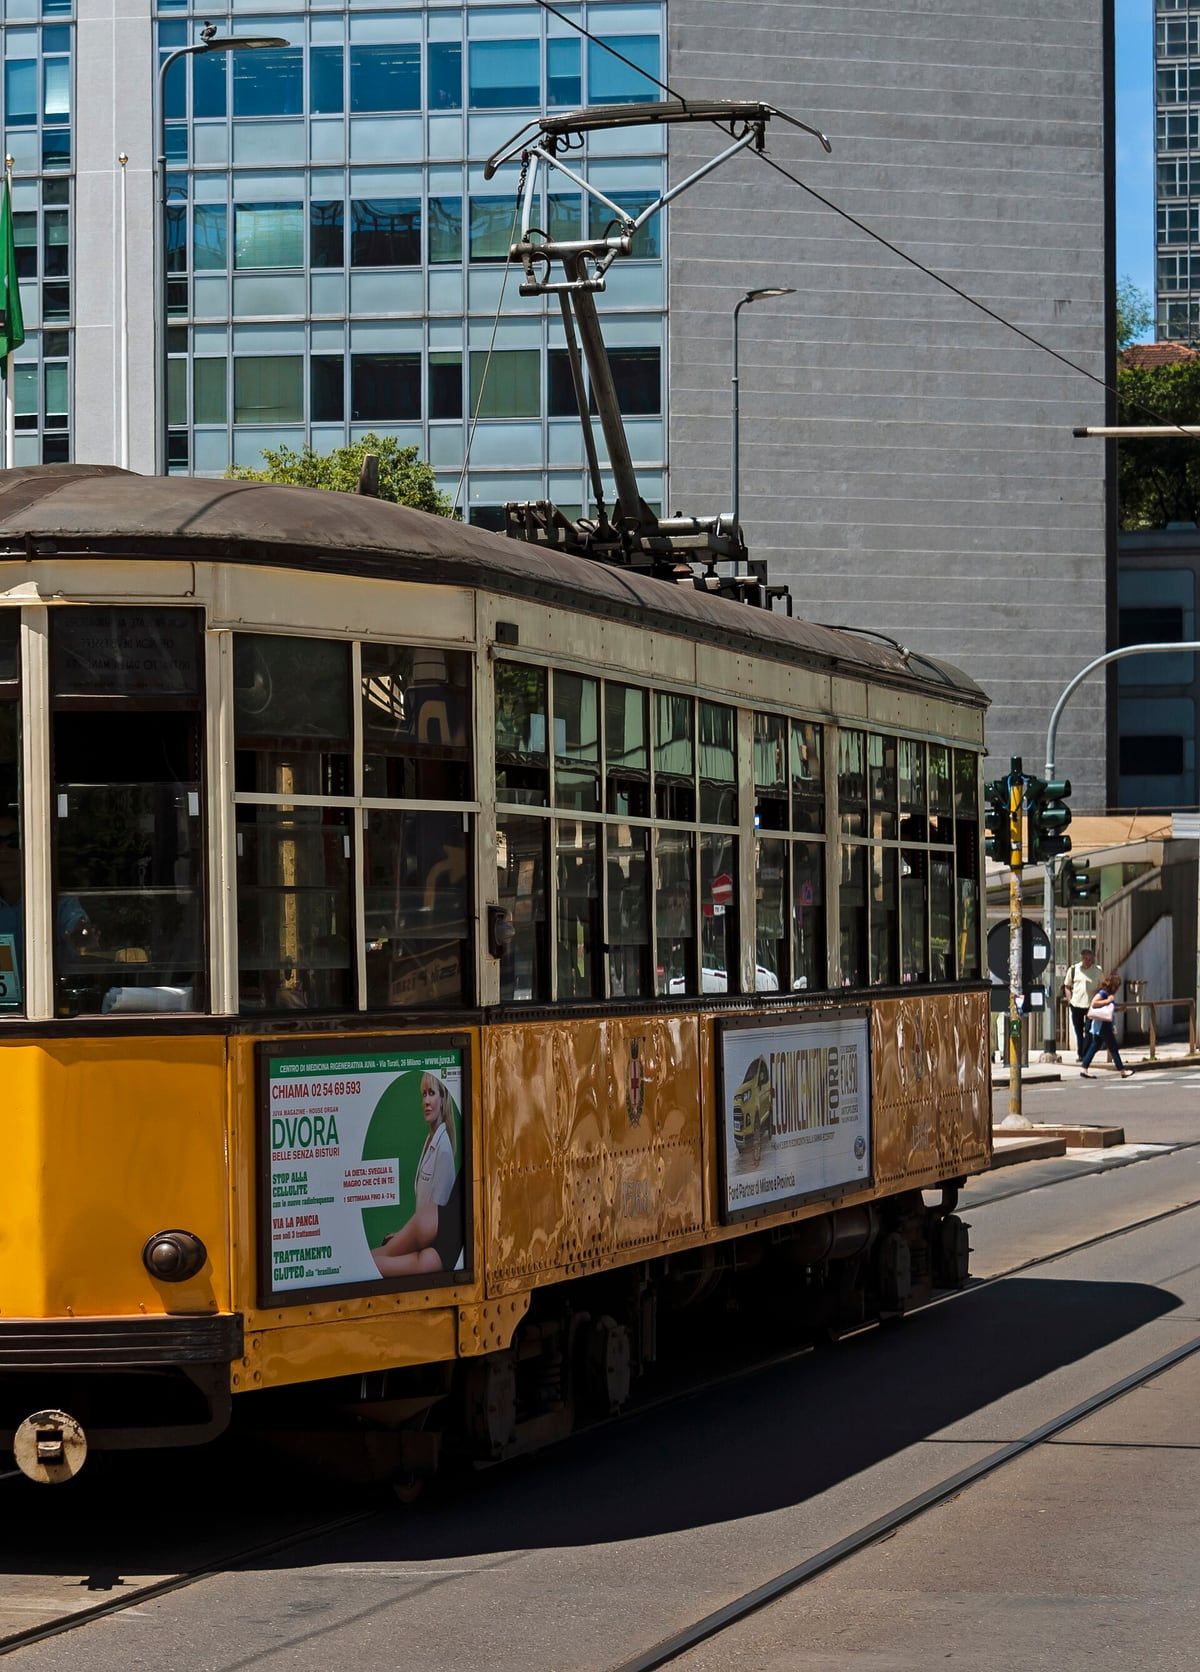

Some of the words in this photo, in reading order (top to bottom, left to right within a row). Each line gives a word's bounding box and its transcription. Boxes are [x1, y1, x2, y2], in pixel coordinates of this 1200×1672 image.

[280, 1064, 299, 1073] CENTRO
[300, 1064, 306, 1072] DI
[306, 1063, 329, 1072] MEDICINA
[330, 1061, 363, 1070] RIGENERATIVA
[364, 1061, 375, 1069] JUVA
[425, 1055, 455, 1066] www.juva.it
[272, 1083, 309, 1099] CHIAMA
[311, 1083, 321, 1097] 02
[322, 1082, 332, 1096] 54
[334, 1081, 344, 1095] 69
[346, 1081, 361, 1095] 593
[828, 1047, 839, 1125] FORD
[284, 1108, 305, 1116] MAGAZINE
[272, 1115, 339, 1149] DVORA
[272, 1151, 291, 1161] BELLE
[293, 1149, 314, 1160] SENZA
[315, 1147, 340, 1158] BISTURI
[272, 1173, 289, 1184] STOP
[291, 1171, 308, 1183] ALLA
[344, 1169, 351, 1177] LA
[352, 1168, 367, 1176] DIETA:
[368, 1166, 388, 1175] SVEGLIA
[343, 1179, 361, 1188] MAGRO
[362, 1178, 372, 1186] CHE
[272, 1184, 308, 1198] CELLULITE
[347, 1194, 370, 1203] SETTIMANA
[273, 1217, 285, 1229] VIA
[285, 1217, 294, 1228] LA
[295, 1214, 319, 1227] PANCIA
[282, 1231, 291, 1239] soli
[273, 1246, 332, 1264] TRATTAMENTO
[273, 1265, 304, 1281] GLUTEO
[305, 1269, 314, 1277] alla
